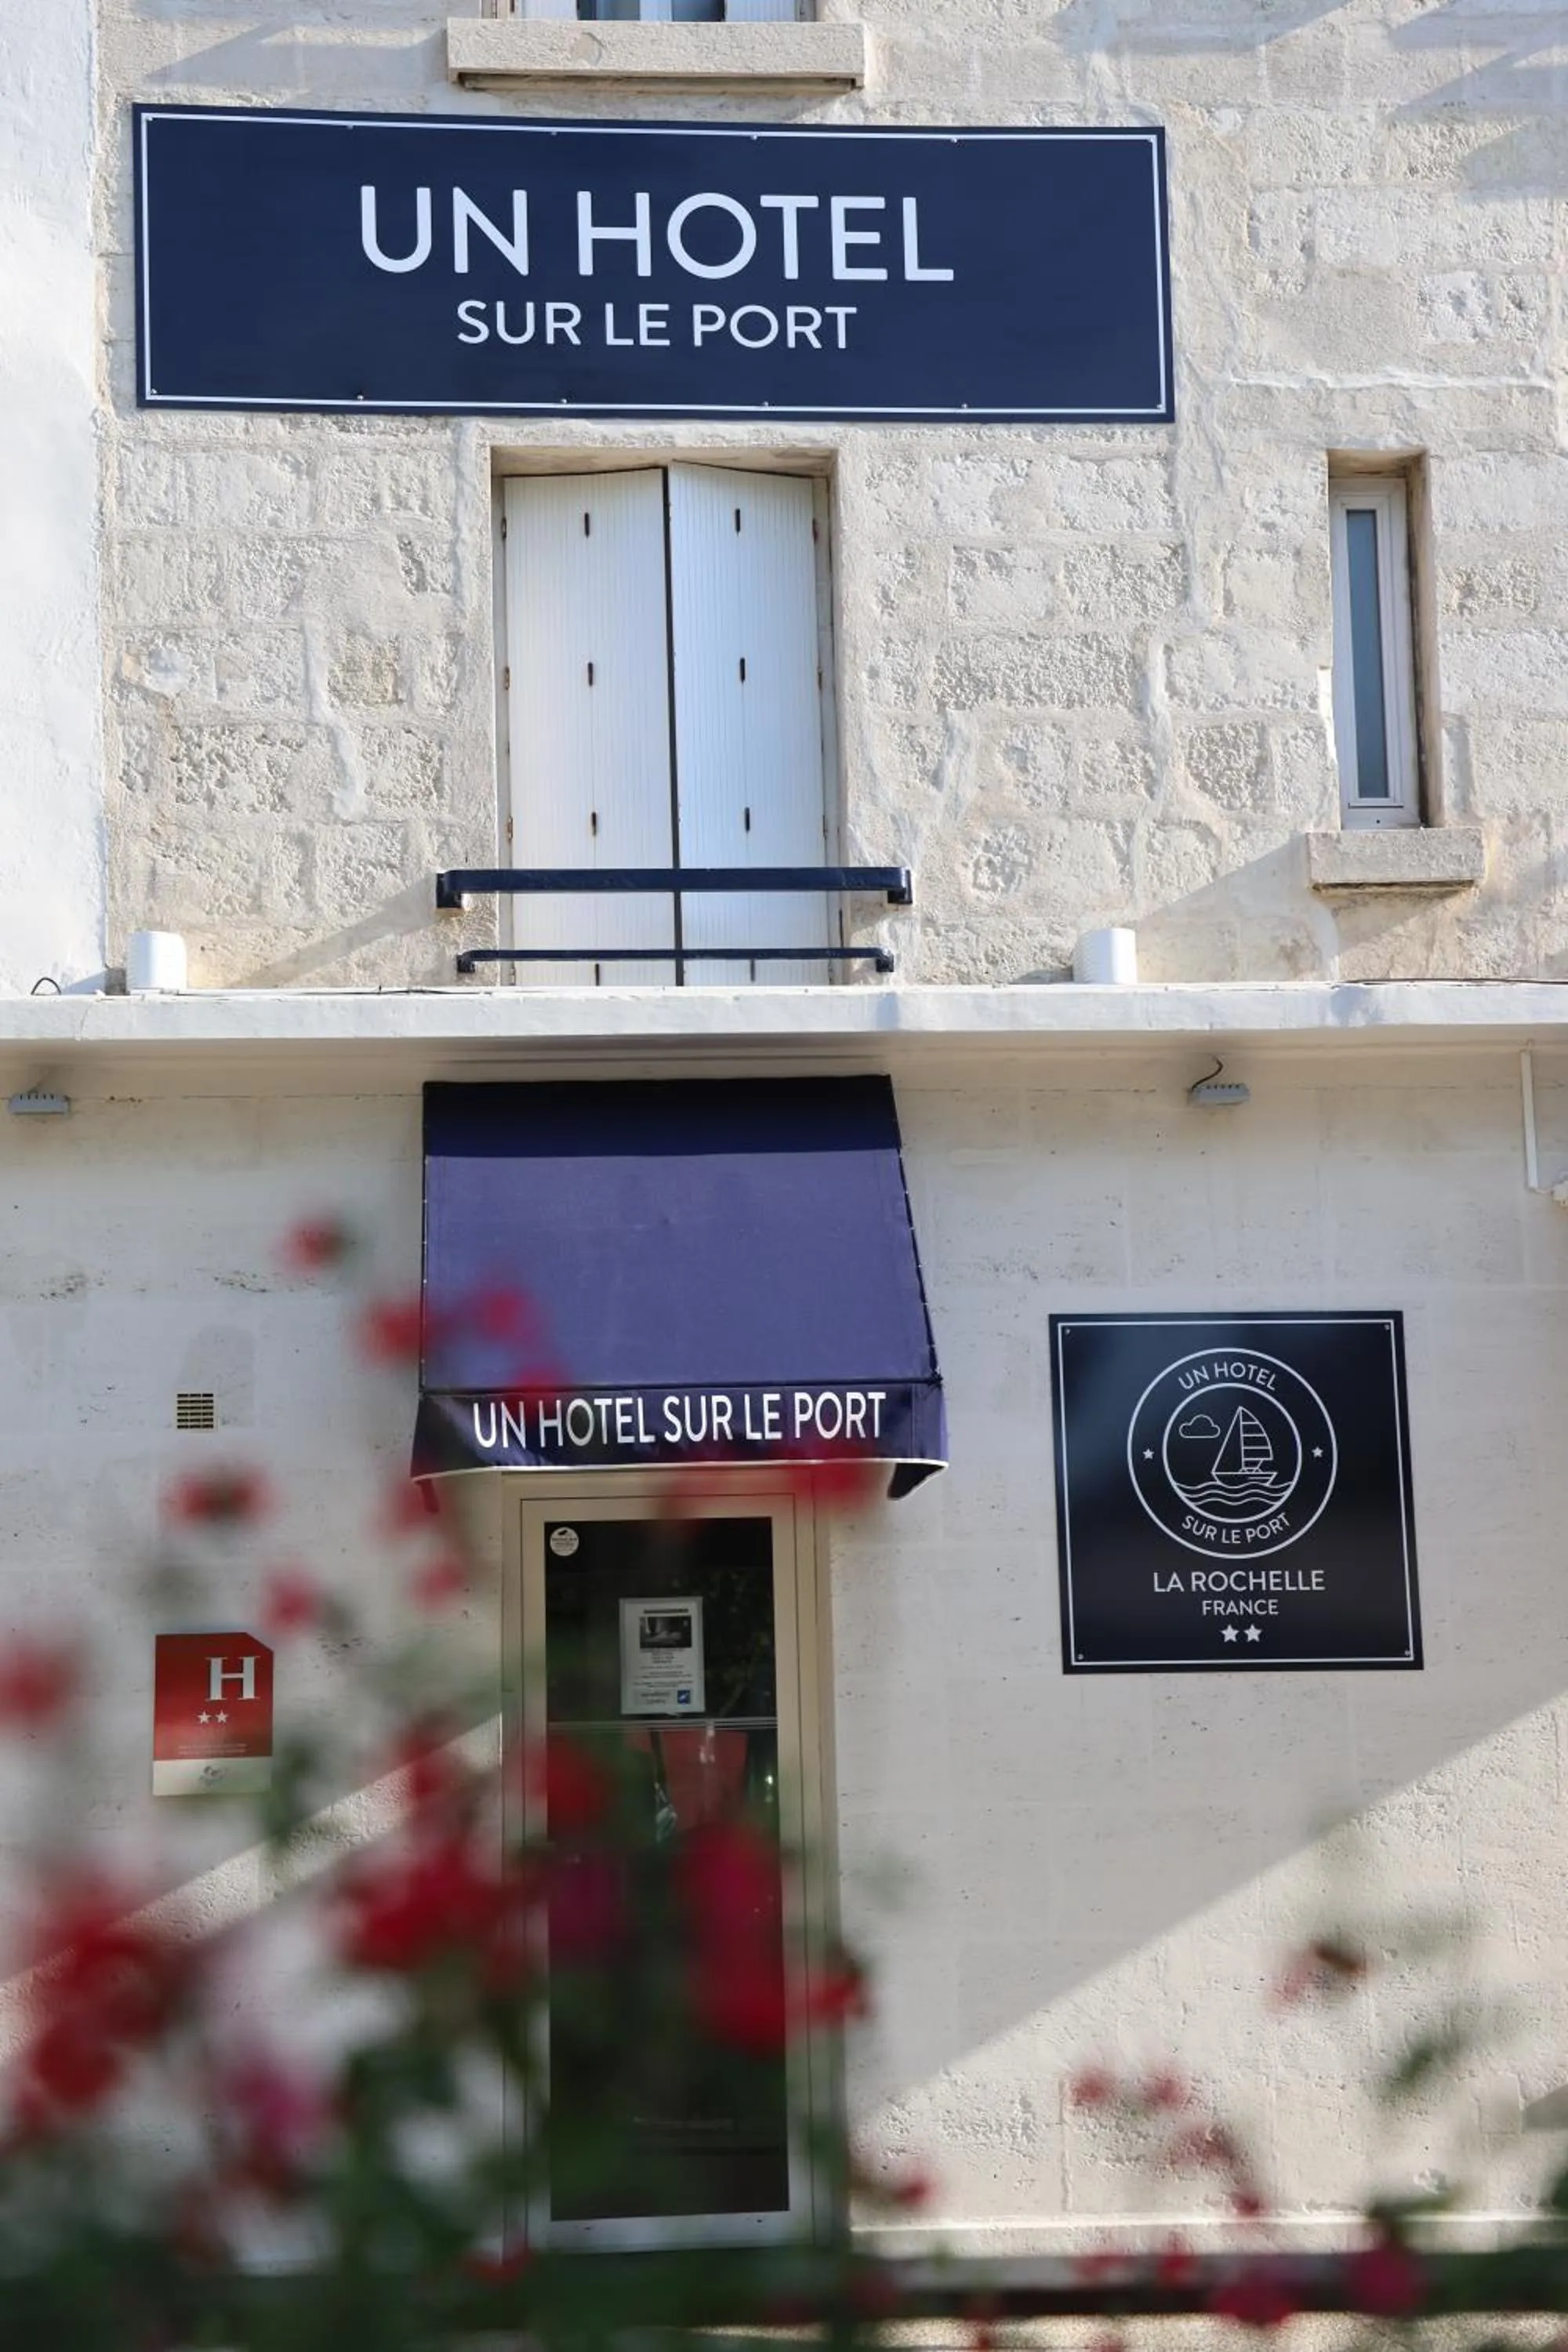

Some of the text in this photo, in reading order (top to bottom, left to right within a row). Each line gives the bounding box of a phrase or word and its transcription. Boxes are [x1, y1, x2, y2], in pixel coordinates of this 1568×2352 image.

[361, 185, 954, 281] UN HOTEL
[457, 300, 857, 349] SUR LE PORT
[1178, 1361, 1276, 1392] UN HOTEL
[473, 1392, 886, 1450] UN HOTEL SUR LE PORT
[1181, 1512, 1290, 1544] SUR LE PORT
[1153, 1570, 1325, 1592] LA ROCHELLE
[1202, 1599, 1279, 1616] FRANCE
[205, 1656, 260, 1701] H
